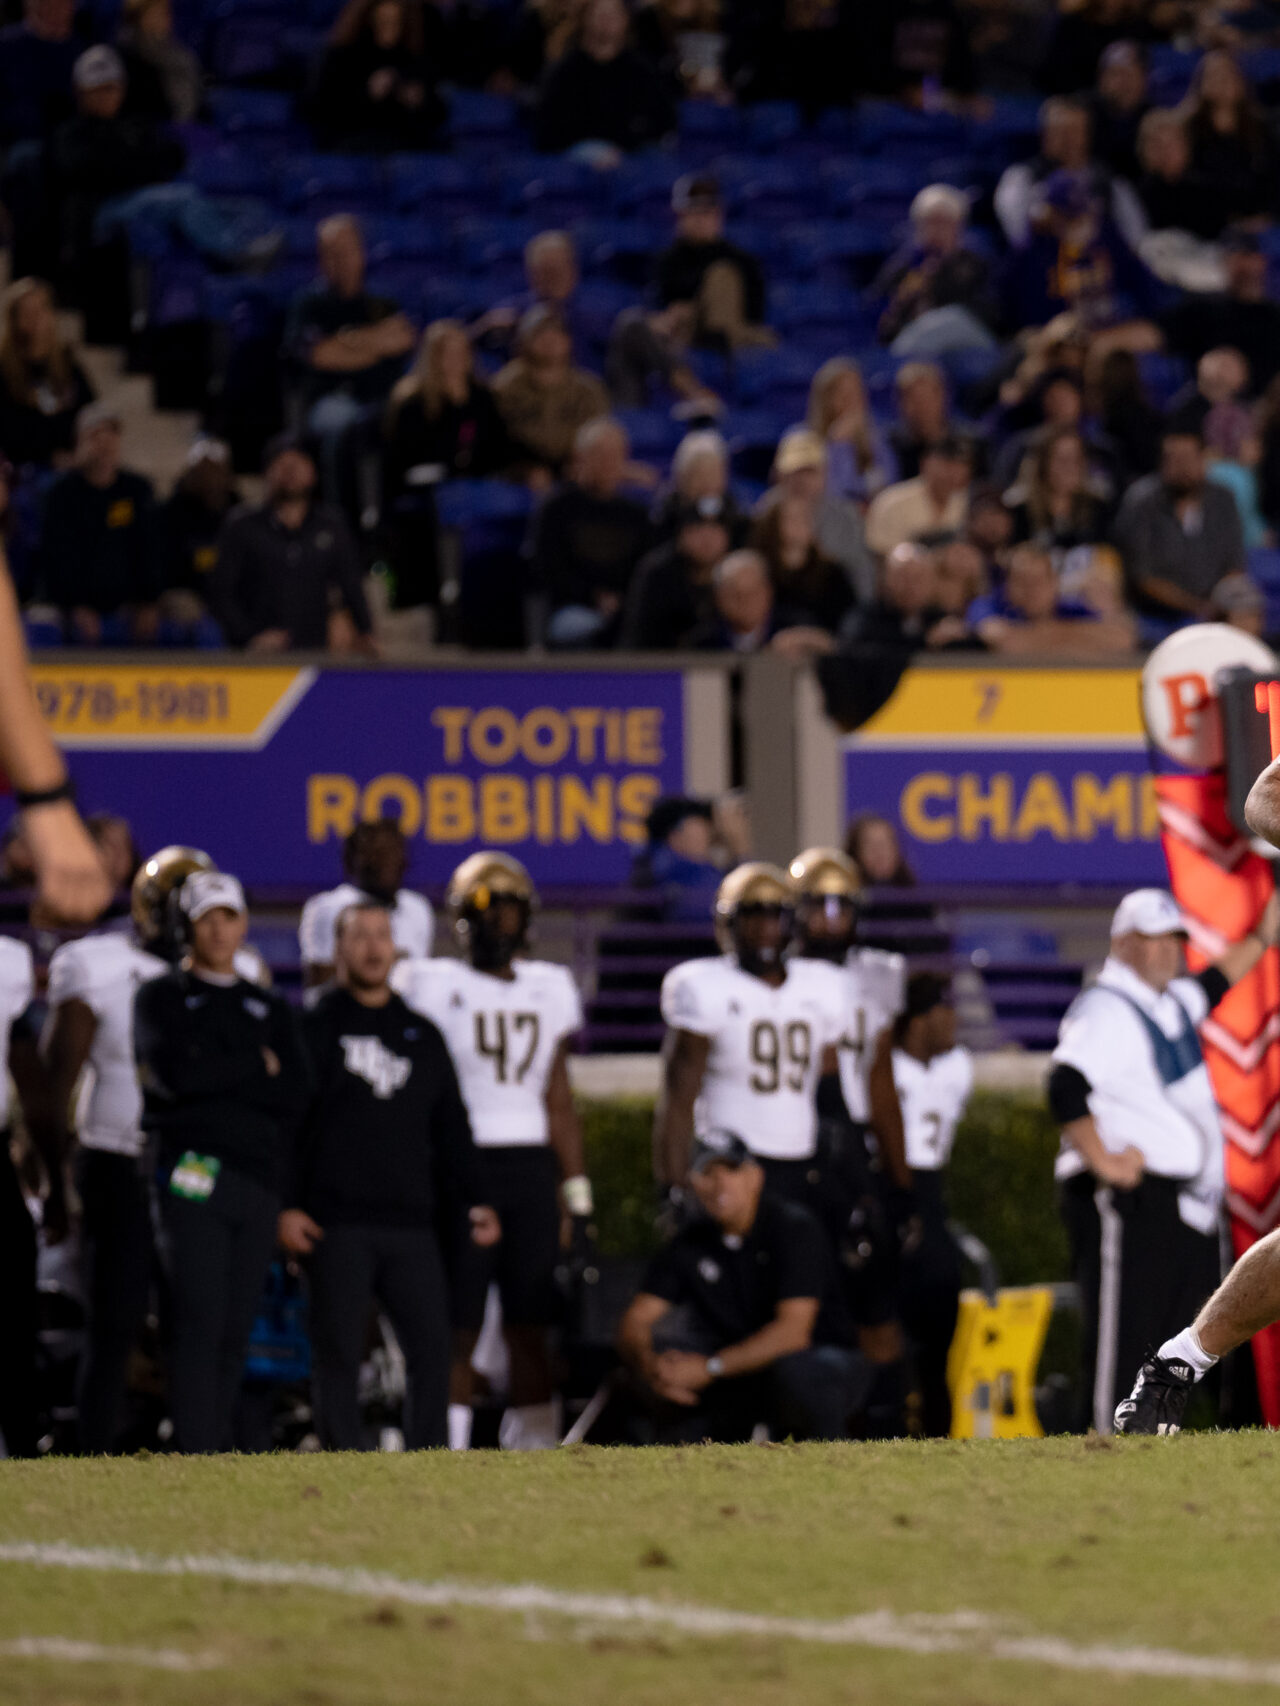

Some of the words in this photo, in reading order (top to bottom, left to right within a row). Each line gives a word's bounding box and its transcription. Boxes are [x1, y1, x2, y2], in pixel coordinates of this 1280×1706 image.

[37, 680, 230, 724] 978-1981
[431, 706, 665, 766] TOOTIE
[1160, 670, 1211, 739] P
[306, 772, 663, 845] ROBBINS
[473, 1010, 540, 1083] 47
[749, 1018, 812, 1090] 99
